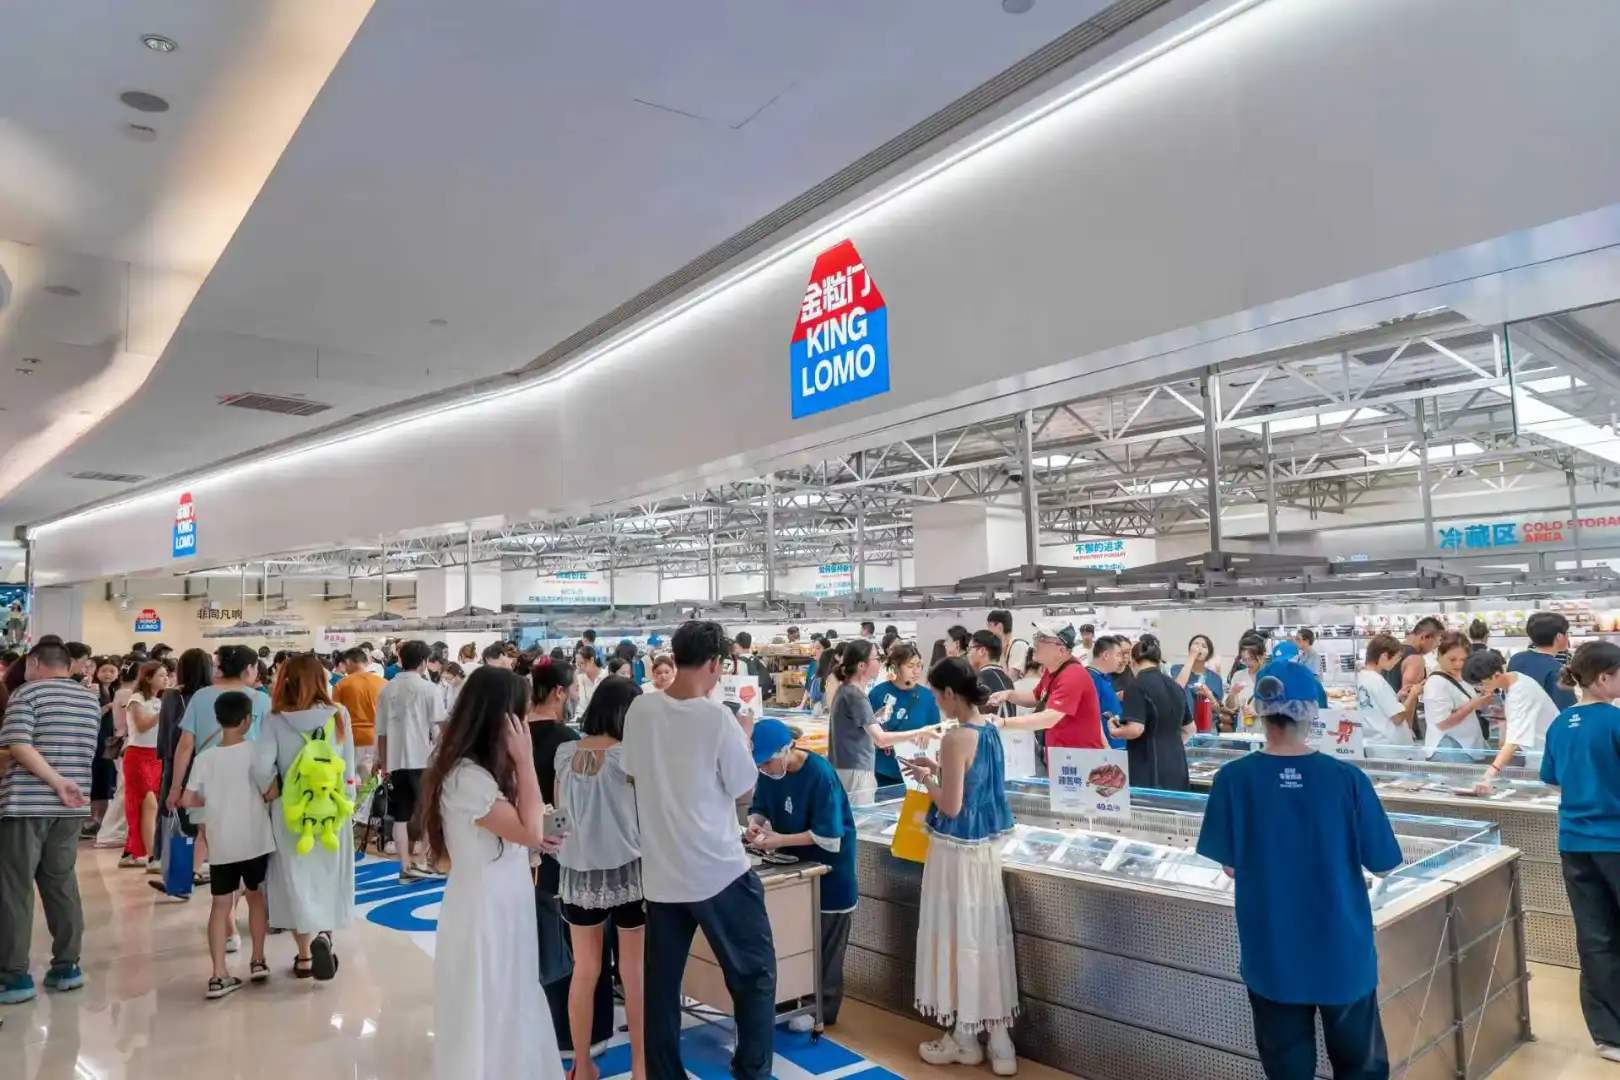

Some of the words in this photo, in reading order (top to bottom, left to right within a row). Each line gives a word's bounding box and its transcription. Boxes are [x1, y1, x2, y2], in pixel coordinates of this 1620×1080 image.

[801, 262, 871, 323] 金粒门
[806, 306, 868, 358] KING
[802, 344, 876, 397] LOMO
[1439, 523, 1519, 549] 冷藏区
[1523, 520, 1563, 532] COLD
[1567, 515, 1620, 529] STORA
[175, 533, 195, 550] LOMO
[1524, 532, 1564, 544] AREA
